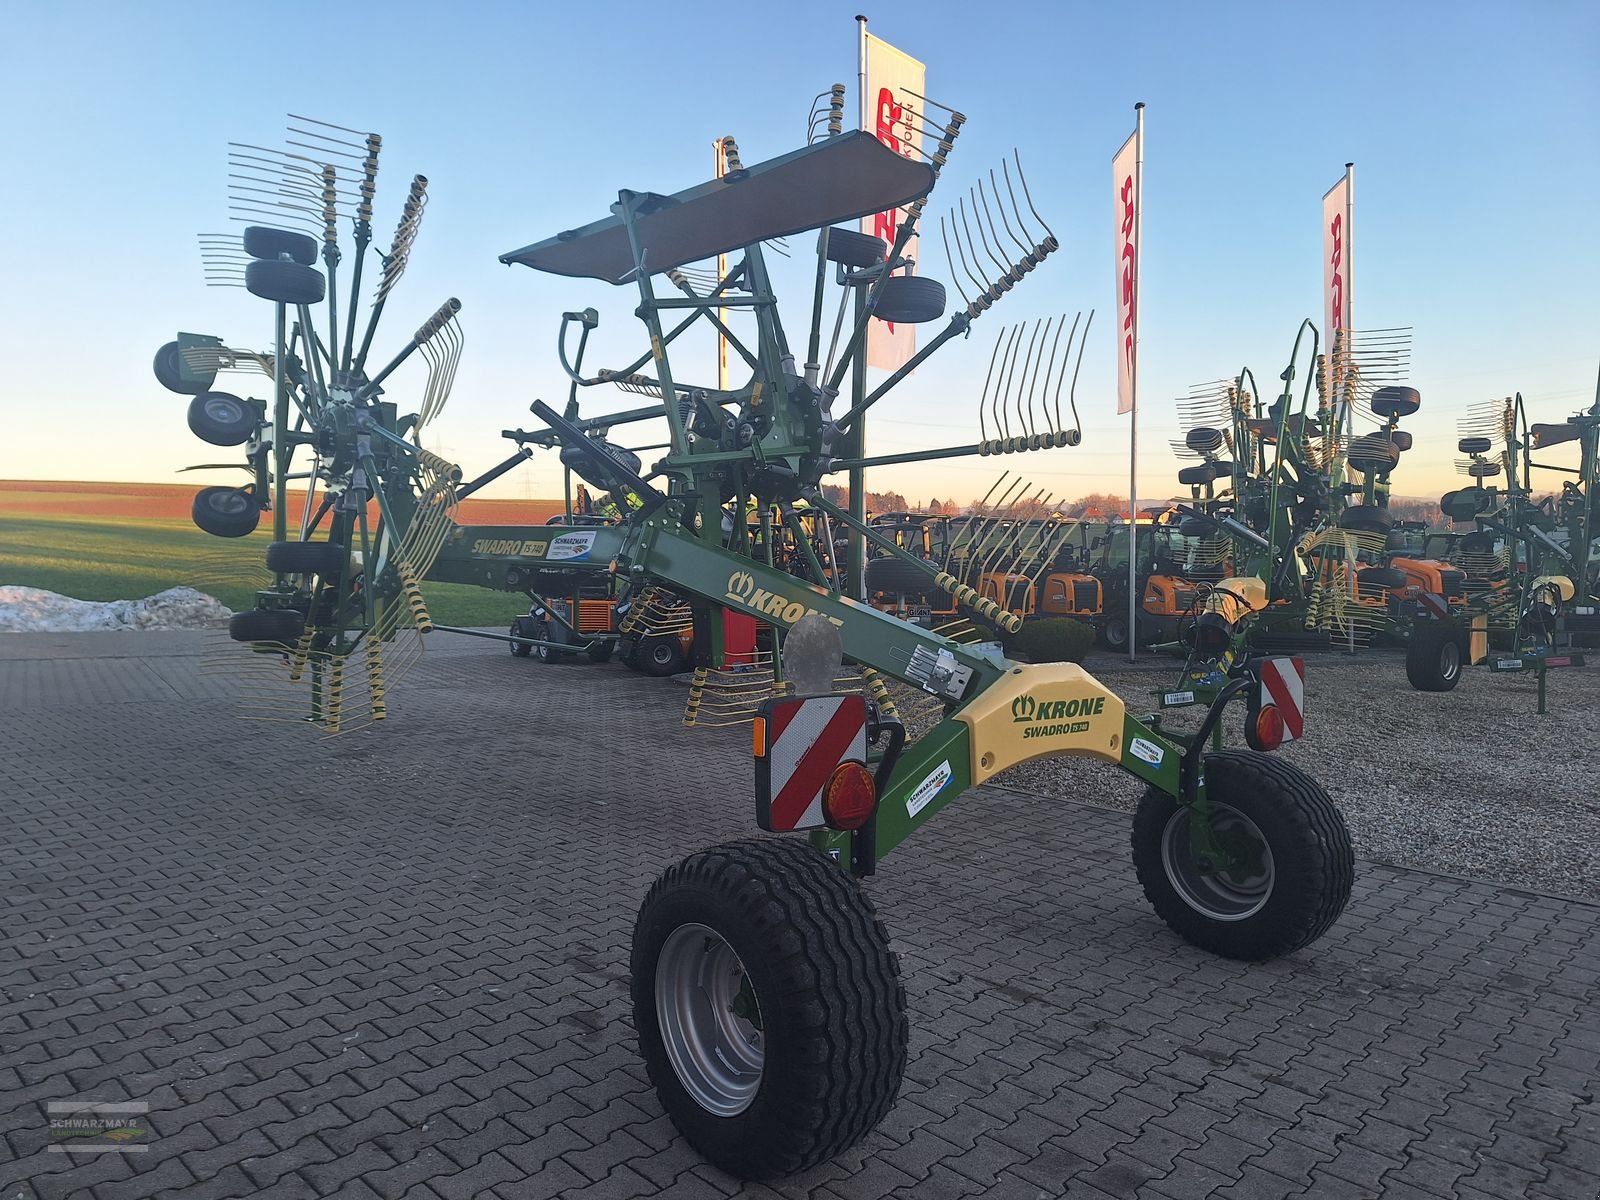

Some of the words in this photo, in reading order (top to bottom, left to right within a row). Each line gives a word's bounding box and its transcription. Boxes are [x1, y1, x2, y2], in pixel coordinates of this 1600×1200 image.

[472, 539, 522, 555] SWADRO
[532, 544, 544, 553] 740
[747, 588, 845, 630] KRO
[1036, 697, 1105, 720] KRONE
[1023, 723, 1070, 739] SWADRO
[910, 770, 944, 803] SCHWARZMAYR
